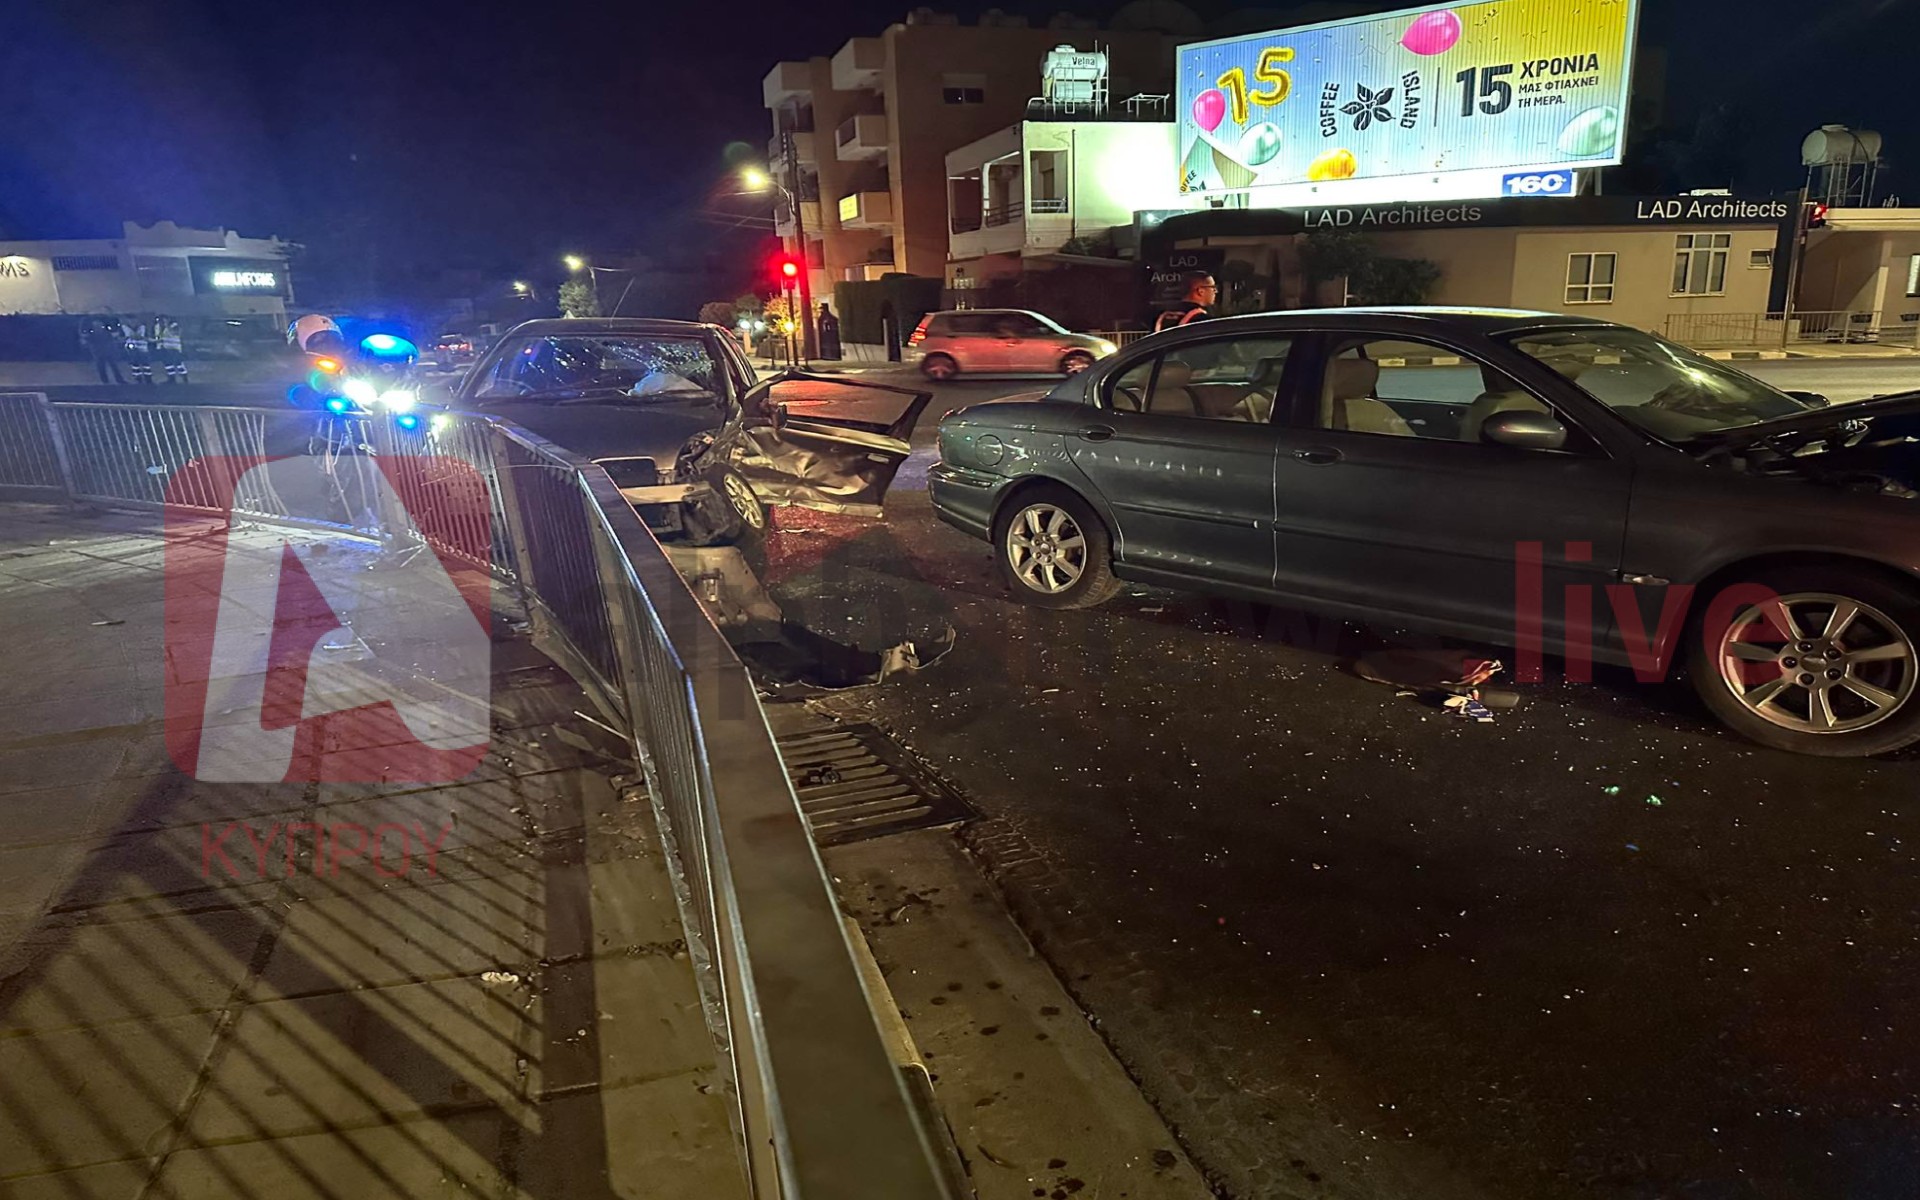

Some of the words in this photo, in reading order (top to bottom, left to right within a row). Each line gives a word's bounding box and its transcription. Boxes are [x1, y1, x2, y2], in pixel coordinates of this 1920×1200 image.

[1519, 53, 1599, 79] ΧΡΟΝΙΑ
[1216, 46, 1295, 124] 15
[1456, 64, 1513, 117] 15
[1518, 83, 1542, 94] ΜΑΣ
[1544, 76, 1599, 91] ΦΤΙΑΧΝΕΙ
[1319, 82, 1340, 138] COFFEE
[1399, 70, 1421, 129] ISLAND
[1518, 98, 1530, 108] ΤΗ
[1304, 209, 1353, 228] LAD
[1359, 204, 1482, 226] Architects
[1636, 200, 1682, 219] LAD
[1686, 200, 1788, 219] Architects
[1169, 255, 1198, 267] LAD
[1150, 271, 1182, 282] Arch
